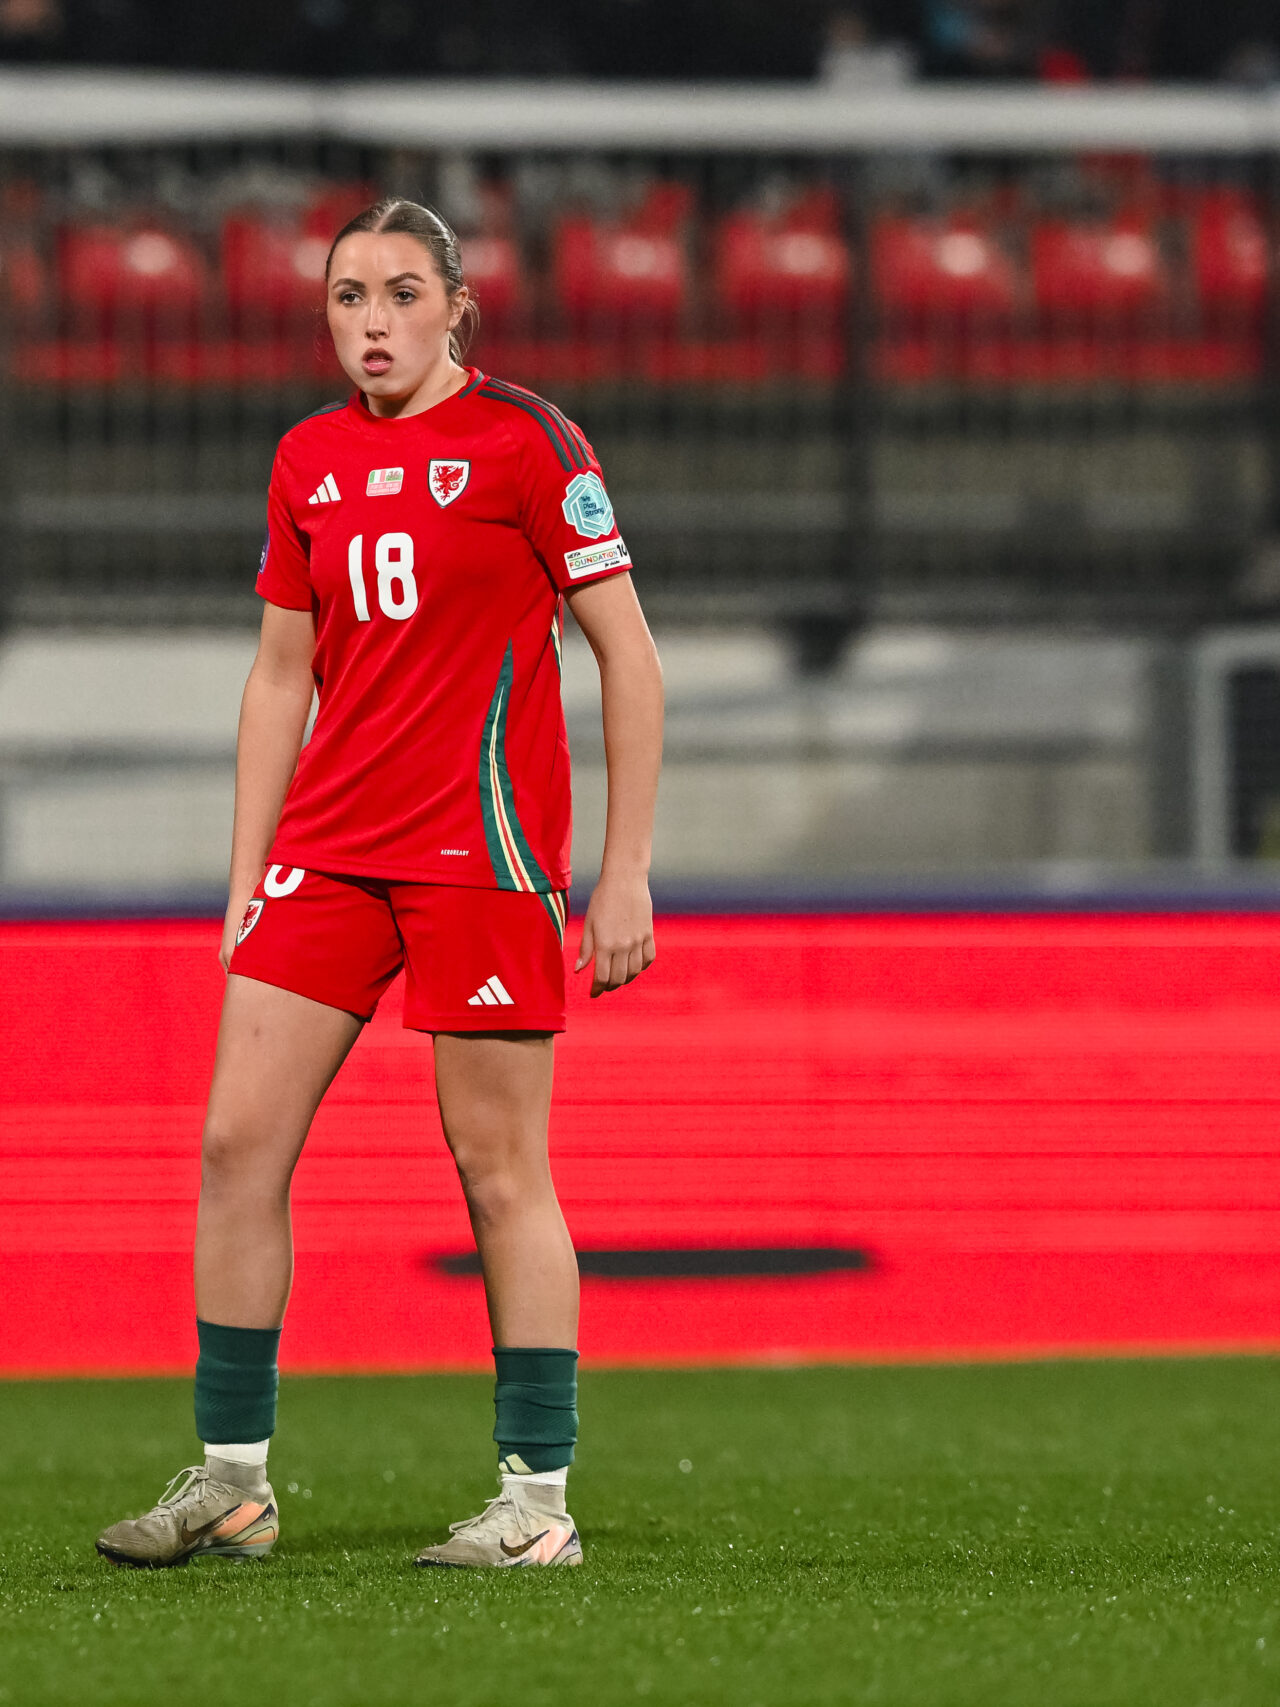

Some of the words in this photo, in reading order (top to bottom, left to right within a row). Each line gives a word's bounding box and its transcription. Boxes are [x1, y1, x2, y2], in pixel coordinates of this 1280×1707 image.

[585, 507, 605, 517] Strong
[569, 550, 618, 568] FOUNDATION
[348, 532, 418, 621] 18
